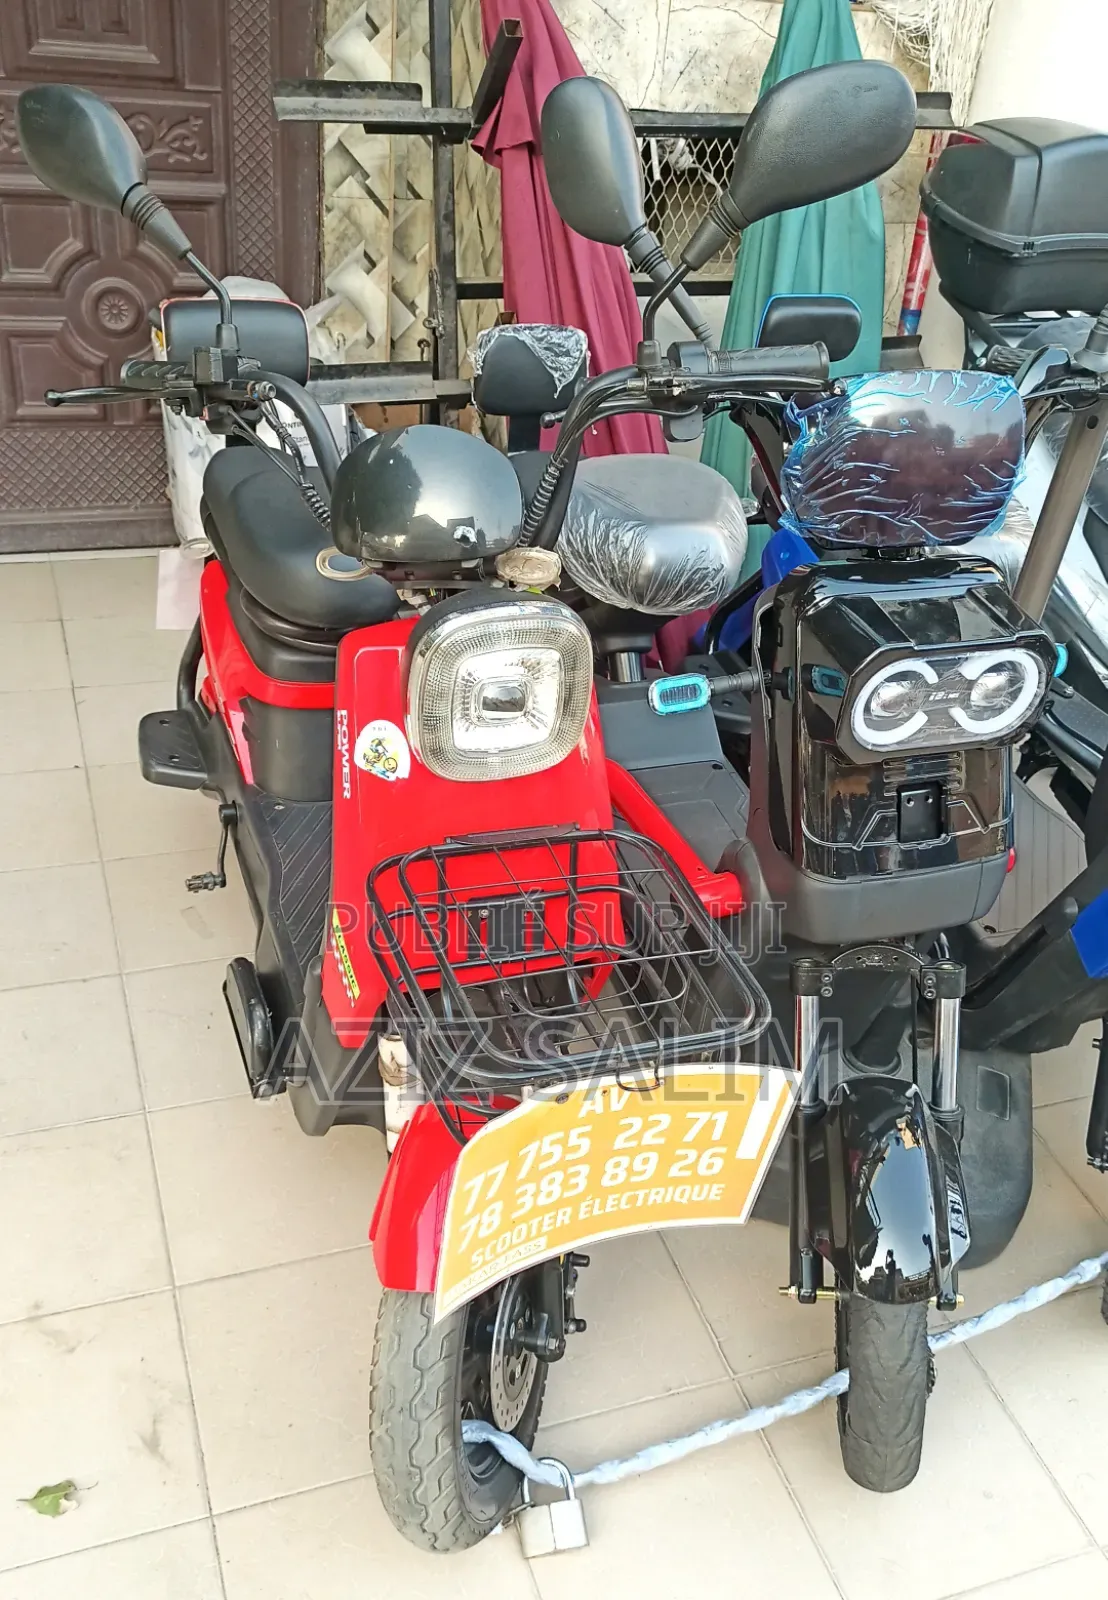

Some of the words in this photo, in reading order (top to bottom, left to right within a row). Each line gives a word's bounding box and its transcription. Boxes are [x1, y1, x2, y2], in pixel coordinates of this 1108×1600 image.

[340, 709, 351, 799] POWER
[459, 1202, 502, 1253] 78
[511, 1164, 590, 1217] 383
[600, 1151, 659, 1188] 89
[668, 1147, 728, 1178] 26
[463, 1161, 509, 1215] 77
[516, 1124, 593, 1181] 755
[612, 1115, 672, 1150] 22
[682, 1111, 729, 1142] 71
[470, 1207, 572, 1269] SCOOTER
[578, 1185, 725, 1218] ÉLECTRIQUE
